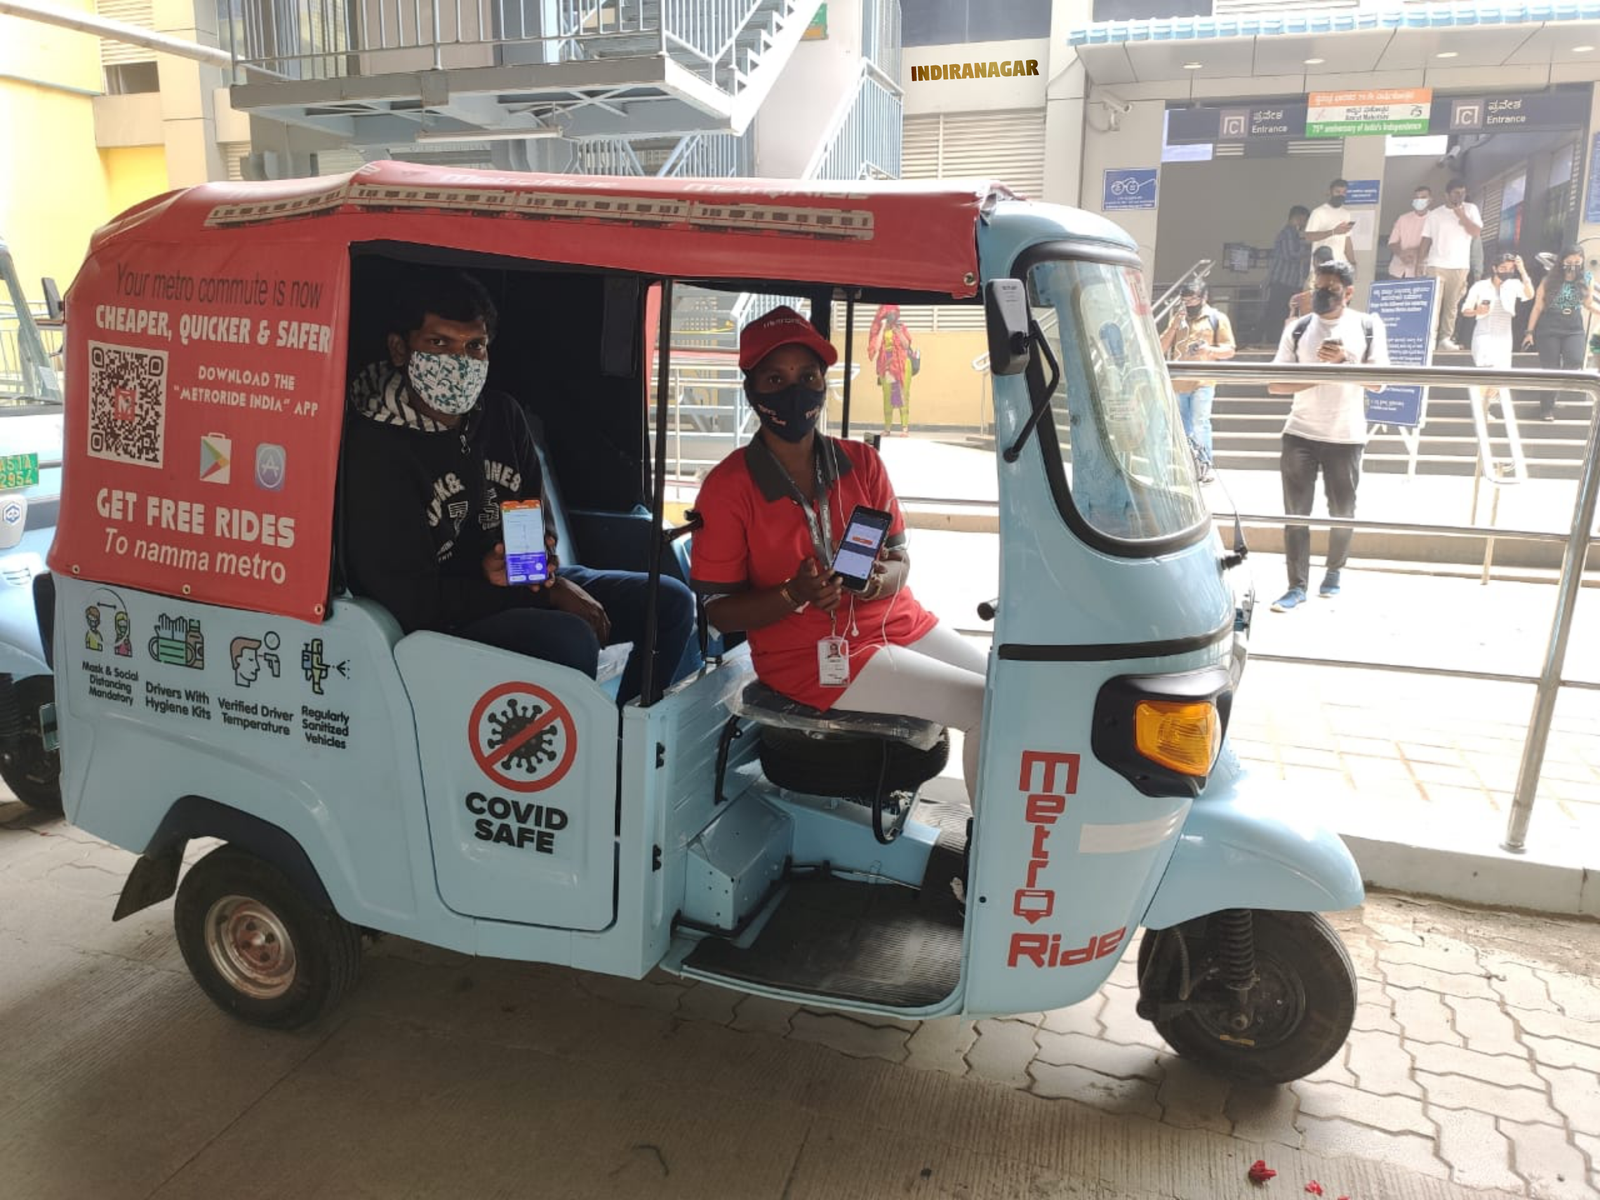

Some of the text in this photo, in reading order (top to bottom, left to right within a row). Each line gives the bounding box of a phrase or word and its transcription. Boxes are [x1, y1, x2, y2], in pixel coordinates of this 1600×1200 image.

[1252, 125, 1288, 134] Entrance
[1487, 115, 1526, 125] Entrance
[117, 262, 323, 310] Your metro commute is now
[96, 304, 331, 353] CHEAPER, QUICKER & SAFER
[198, 365, 295, 391] DOWNLOAD THE
[294, 401, 318, 417] APP
[97, 488, 295, 548] GET FREE RIDES
[105, 527, 286, 584] To namma metro
[82, 660, 139, 682] Mask & Social
[89, 674, 132, 694] Distancing
[89, 686, 134, 706] Mandatory
[145, 680, 210, 705] Drivers With
[145, 696, 211, 720] Hygiene Kits
[217, 697, 294, 722] Verified Driver
[301, 705, 349, 726] Regularly
[222, 711, 290, 736] Temperature
[302, 718, 349, 737] Sanitized
[305, 732, 346, 749] Vehicles
[465, 792, 568, 831] COVID
[474, 818, 555, 855] SAFE
[1007, 926, 1127, 968] Ride
